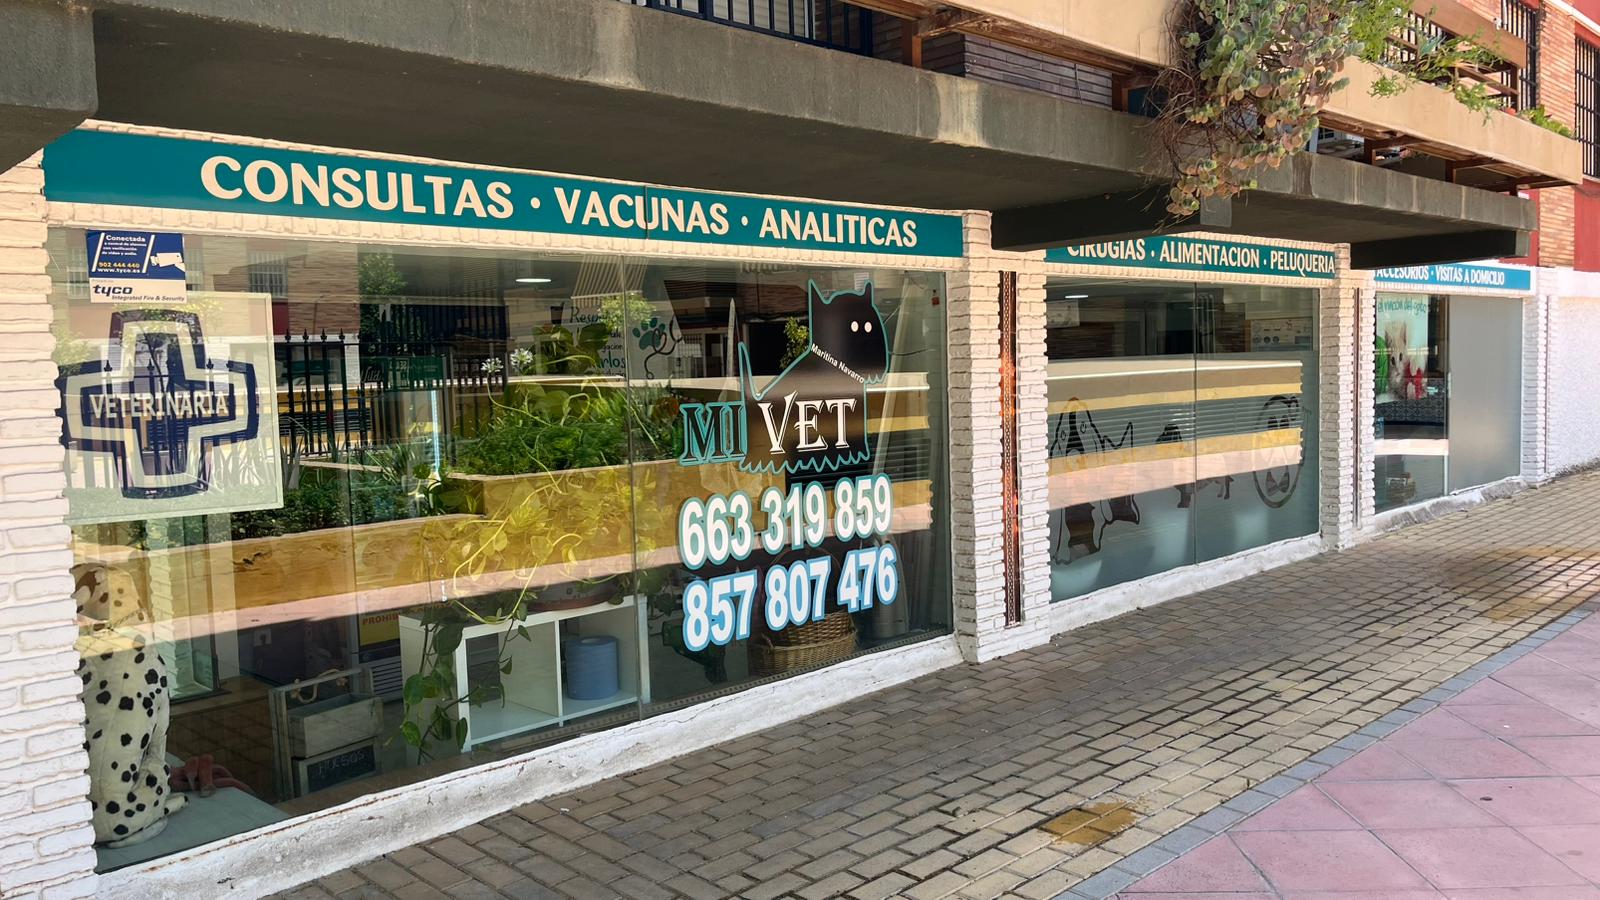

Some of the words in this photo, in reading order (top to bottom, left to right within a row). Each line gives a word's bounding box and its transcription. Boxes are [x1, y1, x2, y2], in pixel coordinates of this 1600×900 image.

[200, 154, 513, 220] CONSULTAS
[553, 186, 730, 235] VACUNAS
[759, 207, 918, 247] ANALITICAS
[105, 234, 146, 242] Conectada
[1159, 240, 1260, 269] ALIMENTACION
[1269, 250, 1336, 278] PELUQUERIA
[1435, 265, 1463, 283] VISITAS
[1464, 268, 1470, 284] A
[1470, 269, 1505, 286] DOMICILIO
[92, 284, 133, 296] tyco
[810, 342, 838, 367] Maritina
[838, 360, 866, 384] Navarro
[89, 390, 229, 419] VETERINARIA
[757, 390, 856, 455] VET
[680, 494, 754, 569] 663
[762, 481, 827, 553] 319
[835, 473, 893, 541] 859
[684, 571, 757, 650] 857
[765, 556, 830, 630] 807
[838, 545, 898, 612] 476
